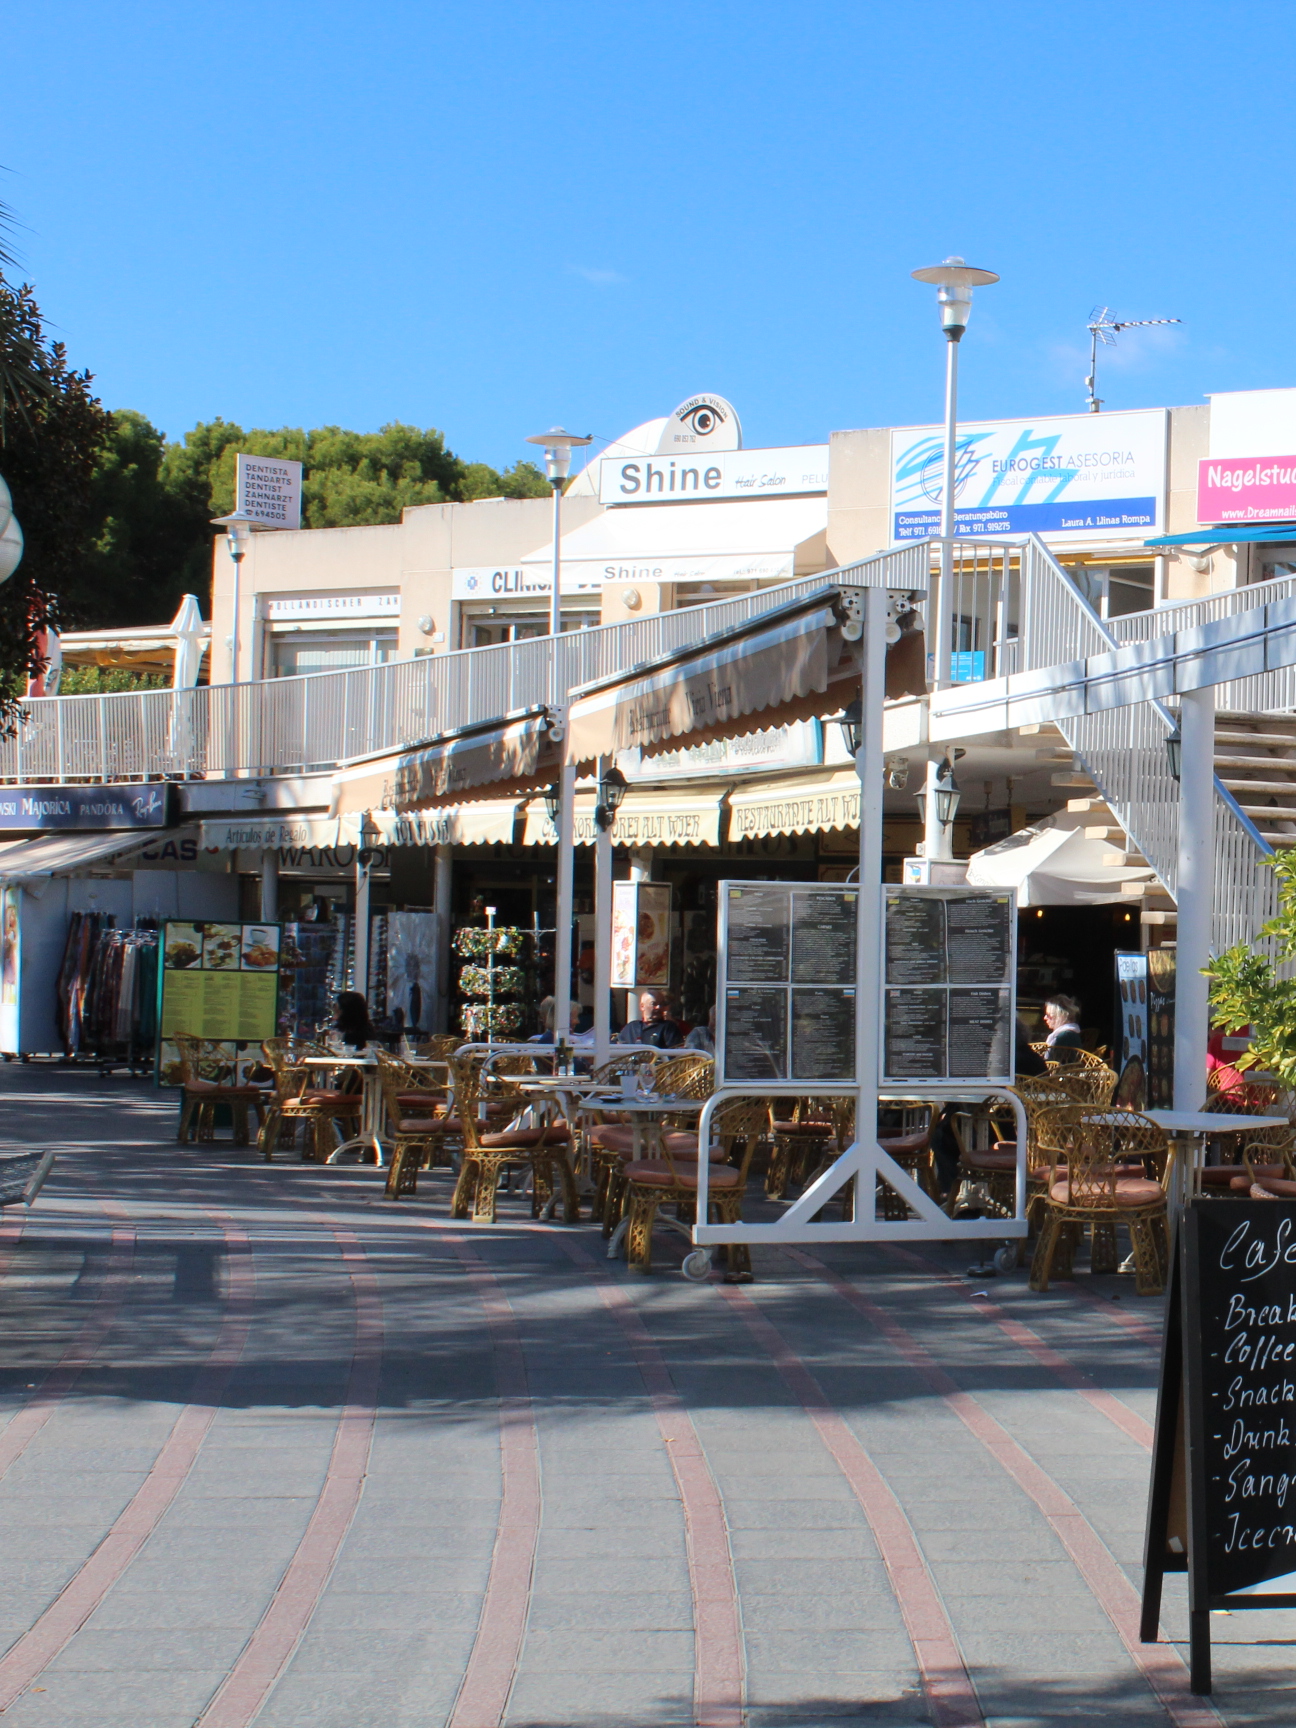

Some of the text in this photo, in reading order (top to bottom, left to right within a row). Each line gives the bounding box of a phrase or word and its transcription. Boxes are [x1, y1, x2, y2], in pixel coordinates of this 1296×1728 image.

[675, 399, 700, 418] SOUND
[709, 398, 728, 418] VISION
[992, 451, 1136, 473] EUROGEST ASESORIA
[245, 464, 288, 476] DENTISTA
[1100, 469, 1136, 482] jurídica
[245, 473, 292, 486] TANDARTS
[620, 462, 722, 495] Shine
[735, 474, 758, 489] Hair
[758, 471, 786, 488] Salon
[245, 482, 282, 493] DENTIST
[245, 491, 293, 503] ZAHNARZT
[245, 500, 287, 512] DENTISTE
[255, 510, 287, 520] 694505
[1062, 518, 1084, 528] Laura
[1085, 517, 1094, 526] A.
[1122, 514, 1150, 525] Rompa
[959, 525, 971, 534] Fax
[603, 565, 663, 580] Shine
[736, 800, 813, 832] RESTAURANTE
[816, 797, 838, 824] ALT
[265, 827, 276, 843] de
[279, 825, 307, 844] Regalo
